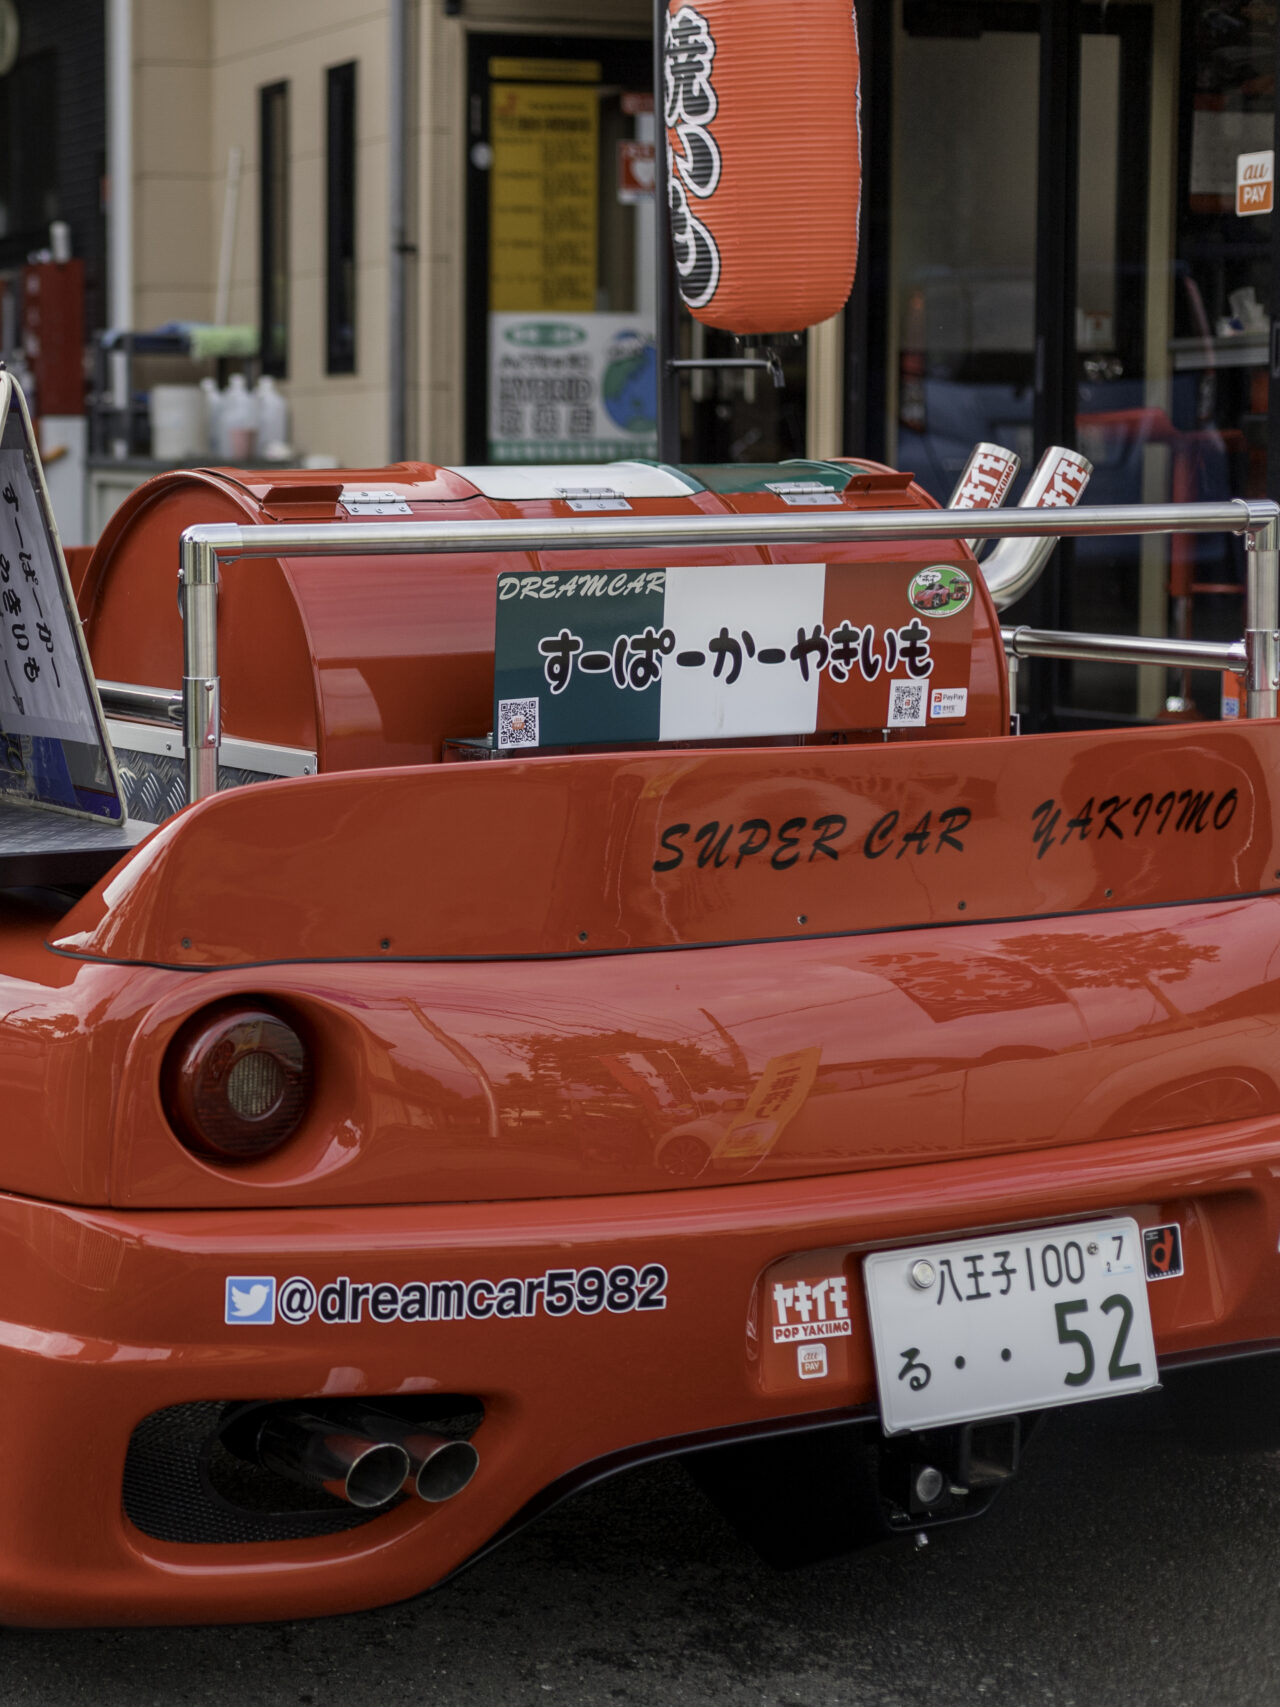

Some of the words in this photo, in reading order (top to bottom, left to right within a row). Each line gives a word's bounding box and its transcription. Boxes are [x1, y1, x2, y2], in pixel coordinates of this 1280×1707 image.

[1243, 164, 1268, 181] au
[1244, 185, 1267, 204] PAY
[499, 572, 666, 600] DREAMCAR
[538, 617, 935, 694] すーぱーかーやきいも
[652, 814, 847, 872] SUPER
[863, 806, 973, 860] CAR
[1033, 787, 1239, 860] YAKIIMO
[278, 1264, 667, 1325] @dreamcar5982
[773, 1277, 848, 1324] ヤキイモ
[775, 1327, 799, 1340] POP
[802, 1321, 849, 1336] YAKIIMO
[804, 1352, 817, 1360] au
[805, 1362, 819, 1371] PAY
